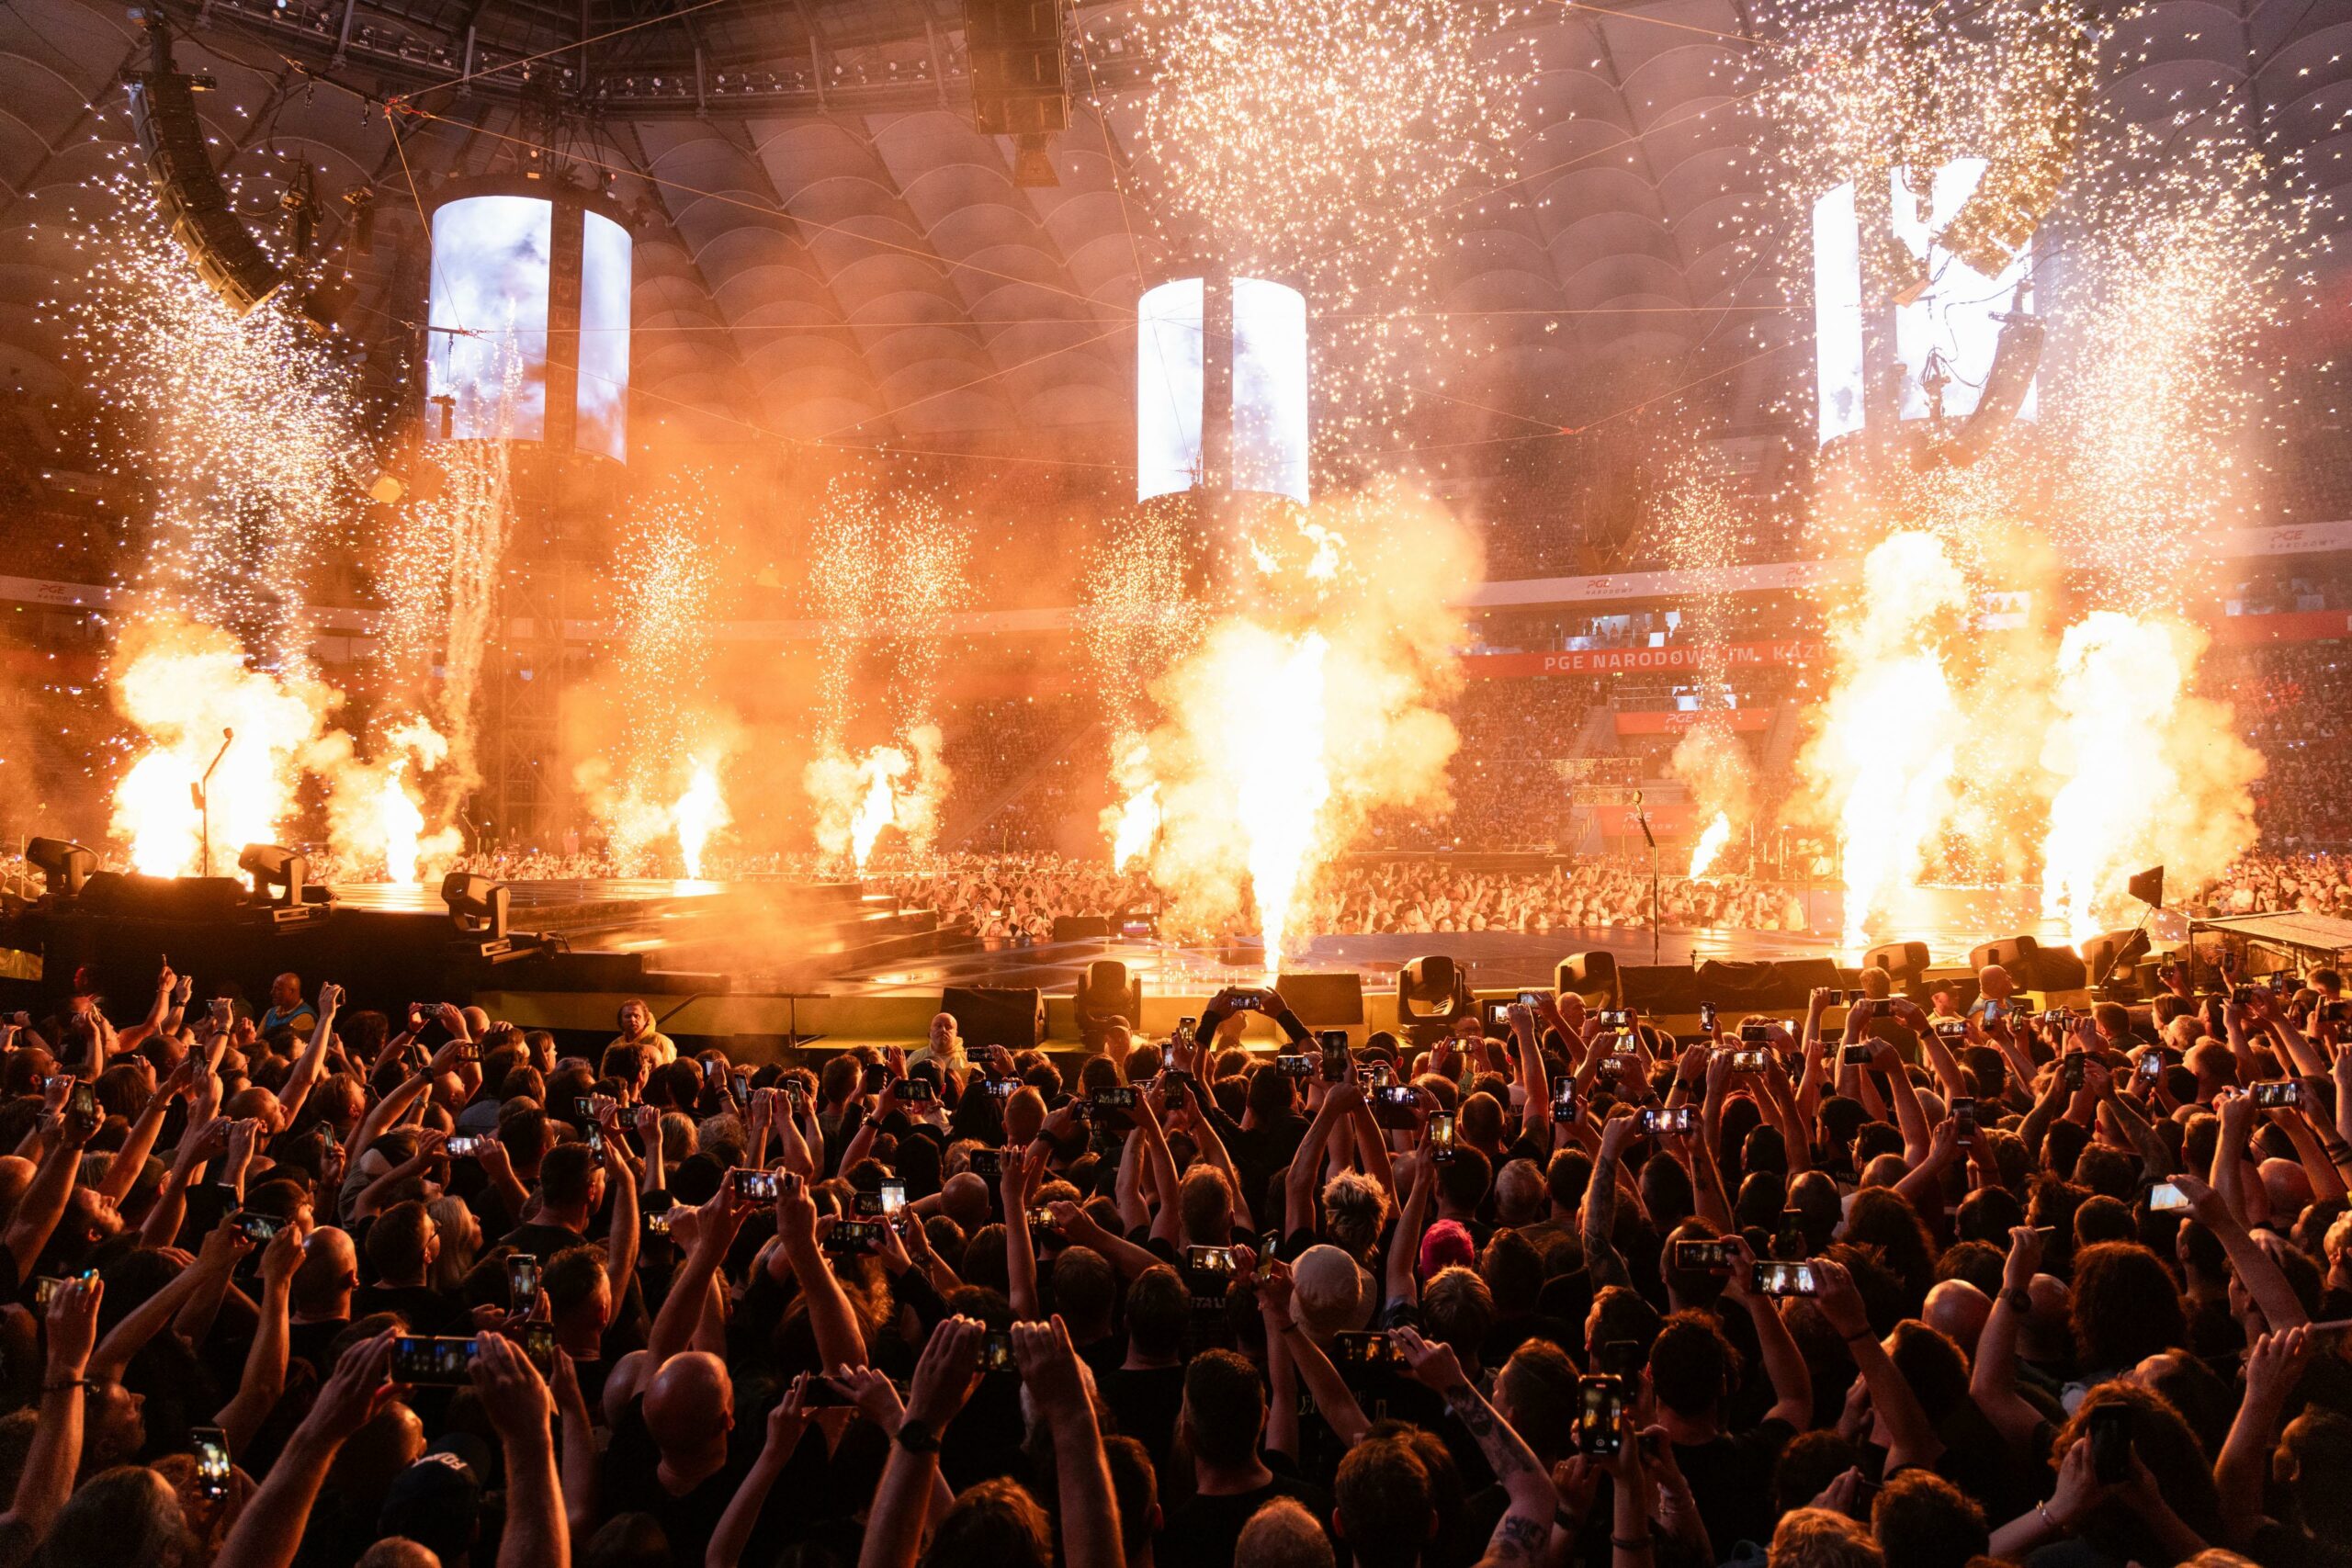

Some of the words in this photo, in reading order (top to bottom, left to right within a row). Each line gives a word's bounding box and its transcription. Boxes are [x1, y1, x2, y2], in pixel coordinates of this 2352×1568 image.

[2271, 530, 2305, 542] PGE
[39, 584, 66, 594] PGE
[1585, 588, 1634, 596] NARODOWY
[1545, 654, 1584, 671] PGE
[1593, 650, 1718, 669] NARODOWY
[1773, 645, 1825, 660] KAZI
[1666, 713, 1695, 724] PGE
